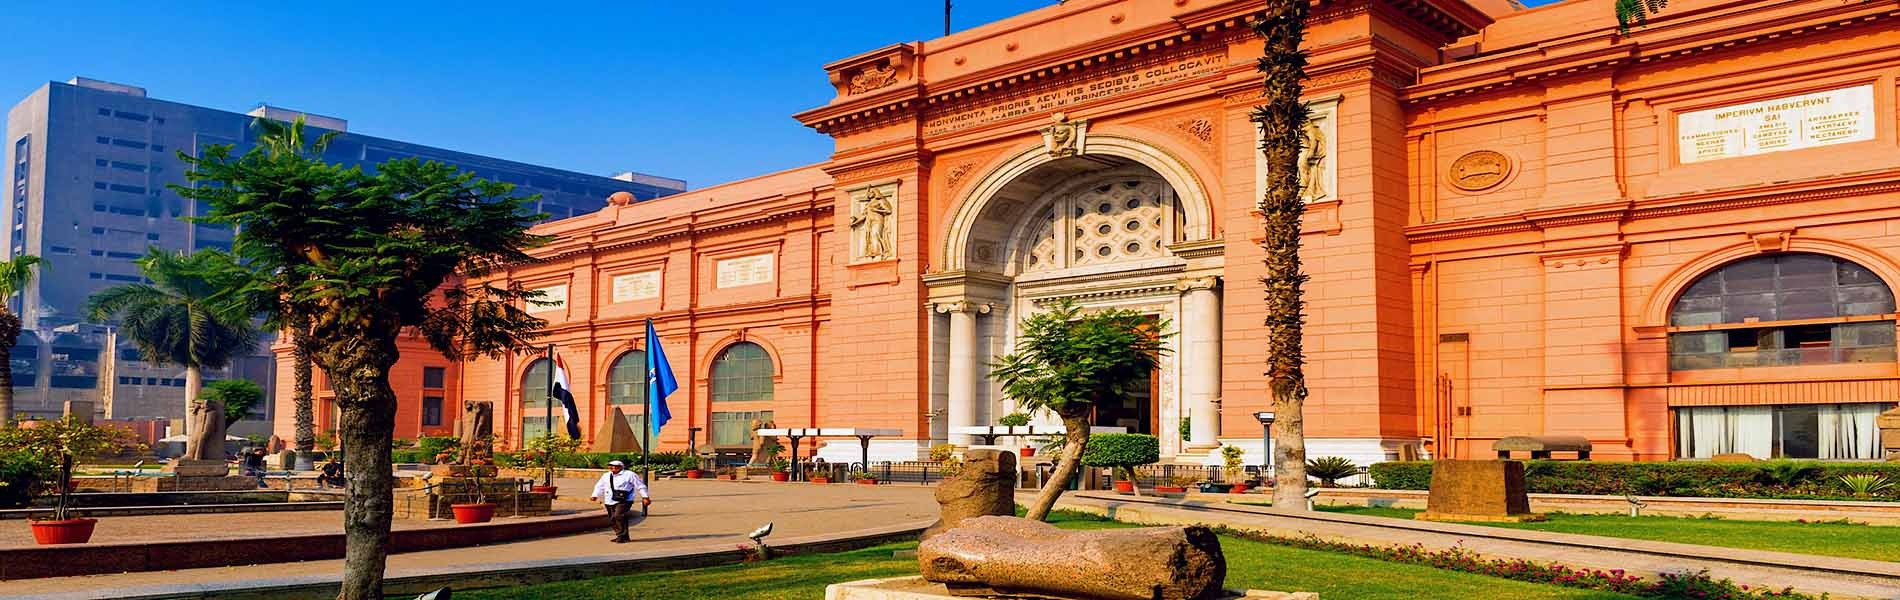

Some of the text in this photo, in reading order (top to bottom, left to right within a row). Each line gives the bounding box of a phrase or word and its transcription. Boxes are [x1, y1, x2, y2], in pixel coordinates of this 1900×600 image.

[929, 111, 986, 129] MONVMENTA
[991, 99, 1031, 114] PRIORIS
[1037, 92, 1061, 103] AEVI
[1066, 87, 1084, 97] HIS
[1090, 74, 1140, 91] SEDIBVS
[1145, 55, 1223, 79] COLLOCAVIT
[1715, 96, 1832, 121] IMPERIVM HABVERVNT
